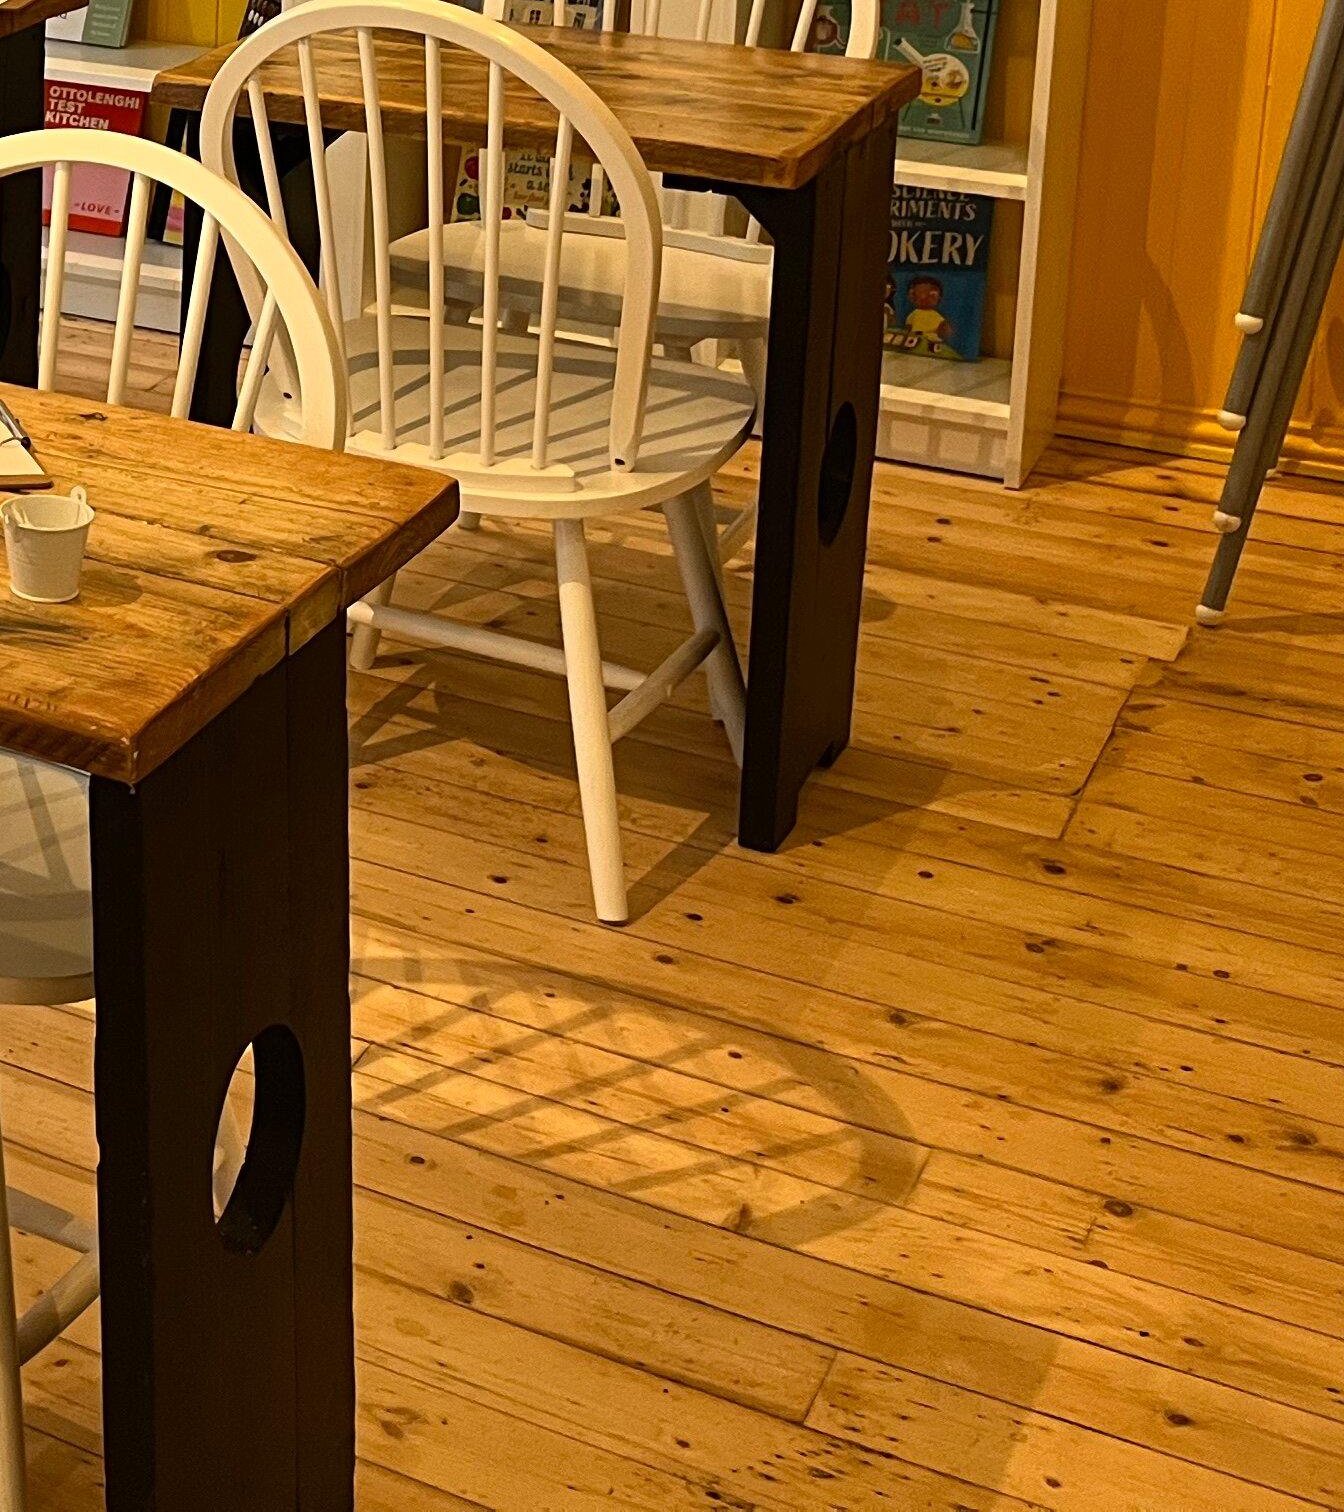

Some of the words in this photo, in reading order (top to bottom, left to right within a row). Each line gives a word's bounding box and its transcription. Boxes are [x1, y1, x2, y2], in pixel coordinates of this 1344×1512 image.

[49, 86, 140, 109] OTTOLENGHI
[49, 99, 86, 114] TEST
[45, 111, 109, 129] KITCHEN
[890, 200, 977, 221] RIMENTS
[889, 230, 984, 265] KERY
